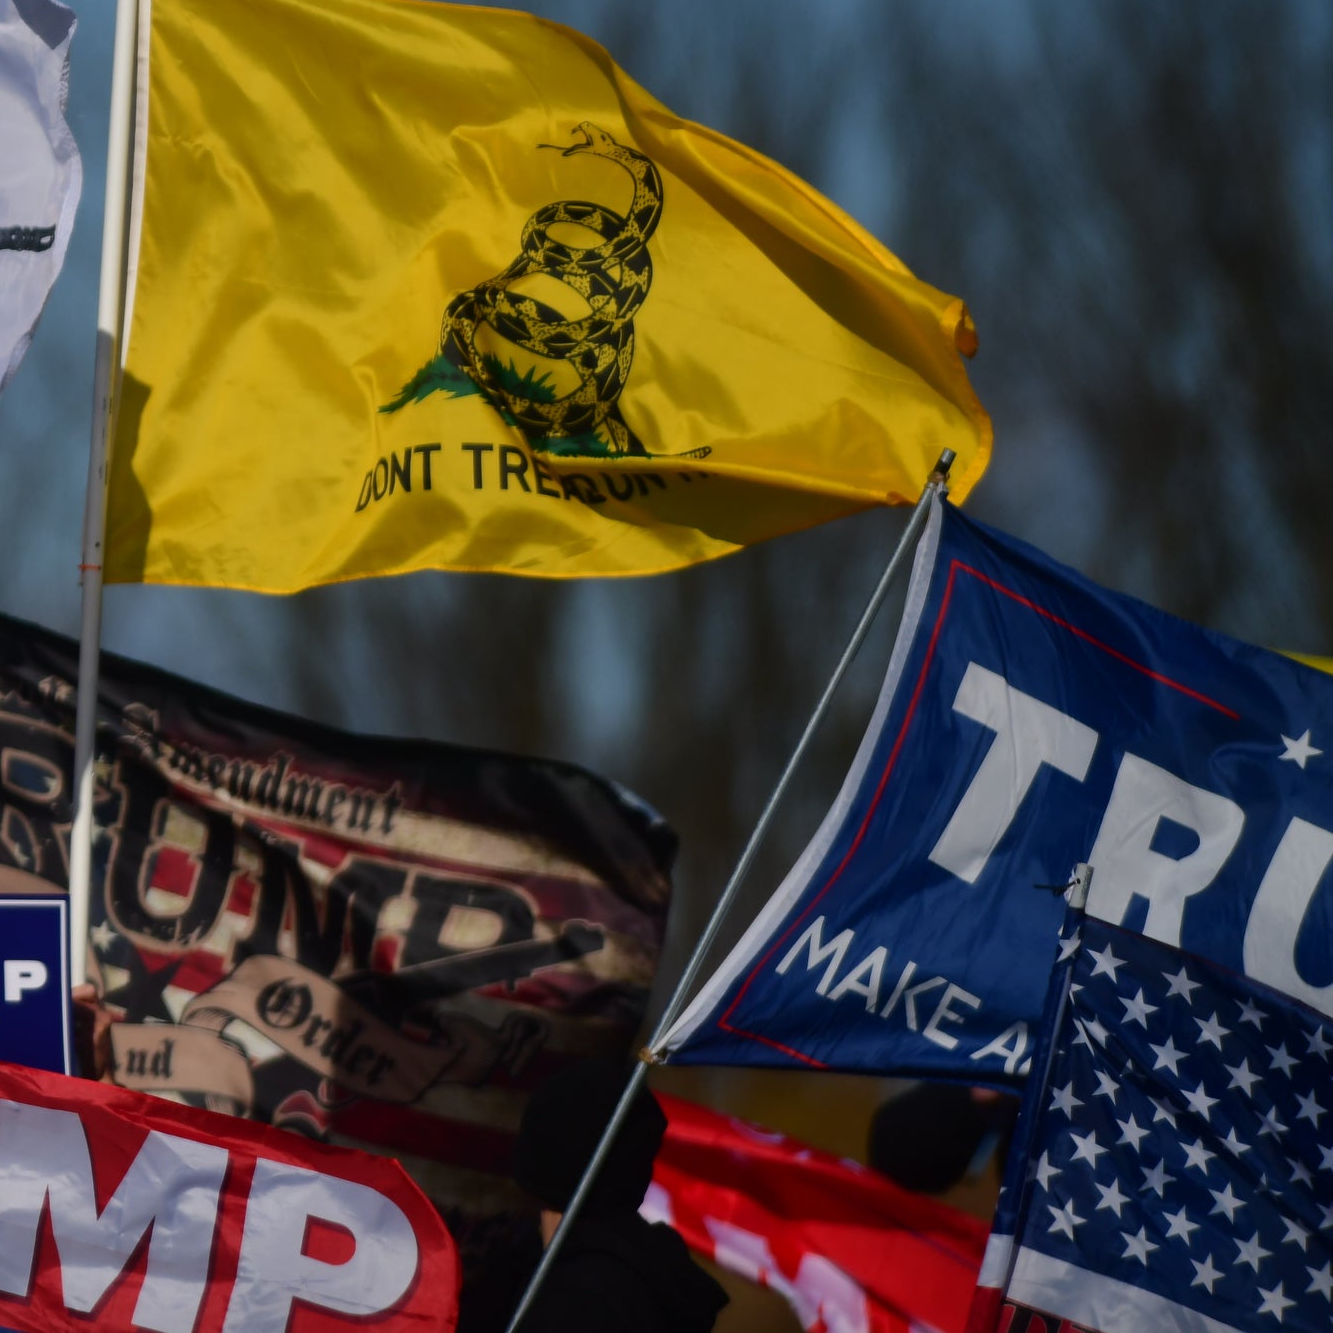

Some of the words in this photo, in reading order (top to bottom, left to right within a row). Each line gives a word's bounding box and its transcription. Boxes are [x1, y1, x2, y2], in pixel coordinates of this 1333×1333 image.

[355, 442, 441, 512] DONT
[256, 978, 394, 1085] Order
[776, 916, 981, 1050] MAKE
